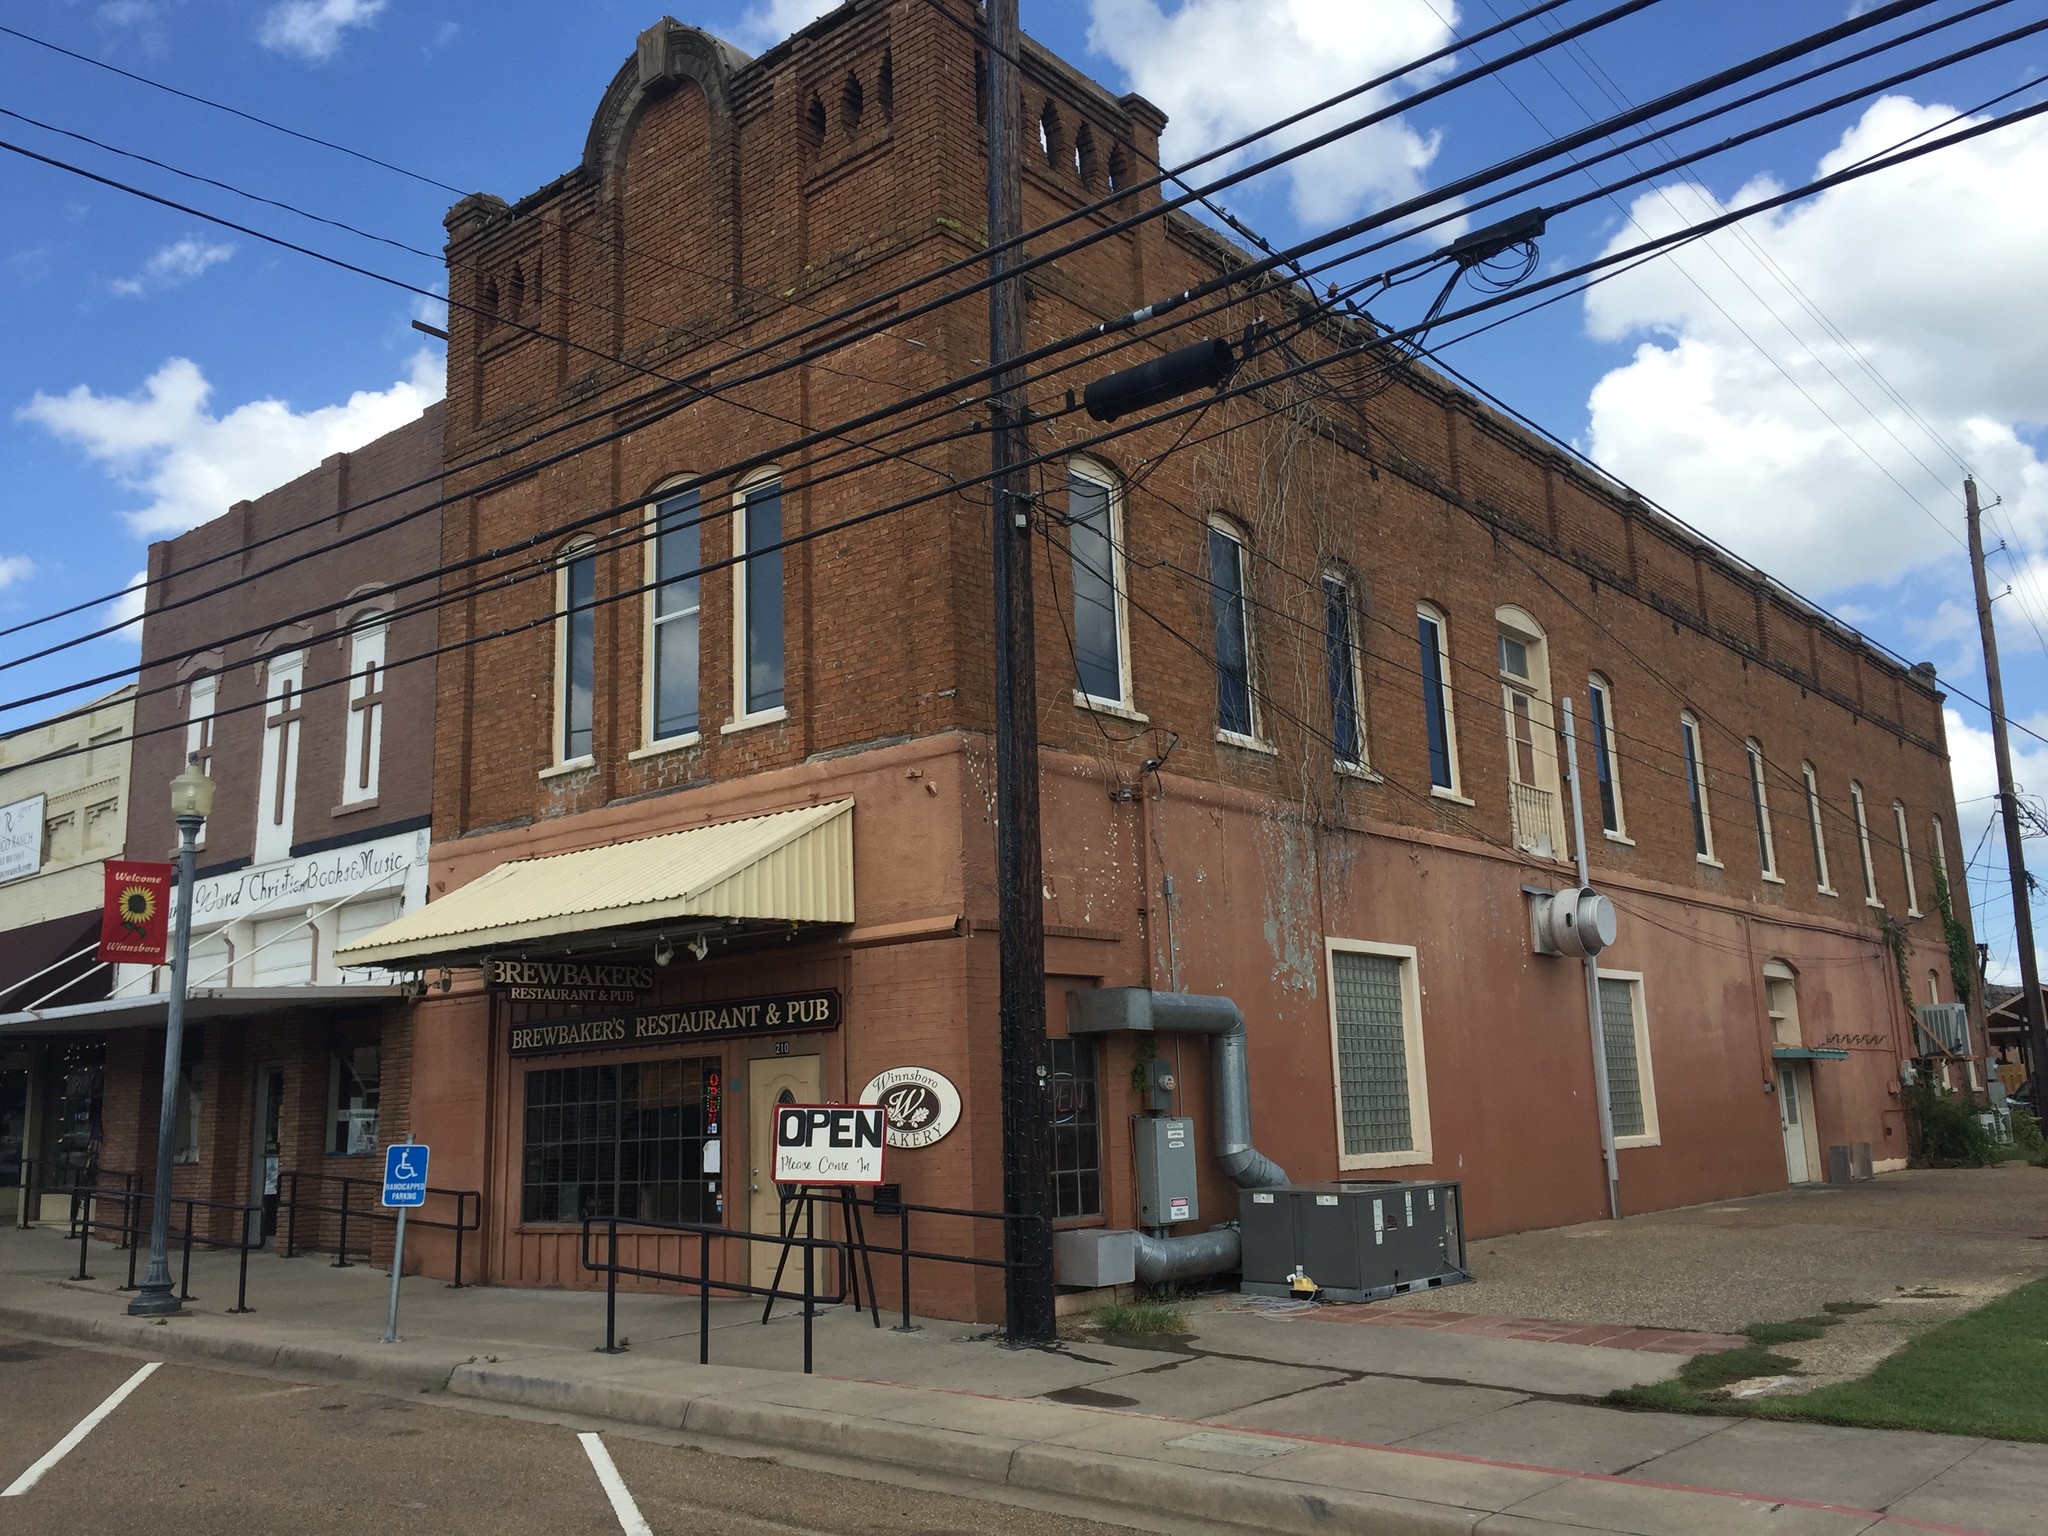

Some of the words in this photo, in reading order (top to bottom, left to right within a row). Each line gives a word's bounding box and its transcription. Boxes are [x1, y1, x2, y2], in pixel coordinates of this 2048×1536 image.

[115, 872, 162, 884] Welcome
[195, 877, 244, 912] Word
[249, 867, 308, 902] Christian
[106, 942, 161, 953] Winnsboro
[493, 960, 653, 988] BREWBAKER'S
[511, 987, 596, 1001] RESTAURANT
[598, 989, 608, 1001] &
[610, 990, 634, 1001] PUB
[511, 1017, 625, 1049] BREWBAKER'S
[635, 1005, 760, 1037] RESTAURANT
[765, 1003, 781, 1025] &
[787, 999, 829, 1024] PUB
[775, 1042, 789, 1054] 210
[872, 1069, 938, 1093] Winnsboro
[778, 1109, 884, 1148] OPEN
[887, 1122, 943, 1147] AKERY
[781, 1155, 812, 1173] Please
[818, 1156, 849, 1174] Come
[857, 1156, 870, 1173] In
[386, 1182, 425, 1190] HANDICAPPED
[391, 1192, 417, 1200] PARKING
